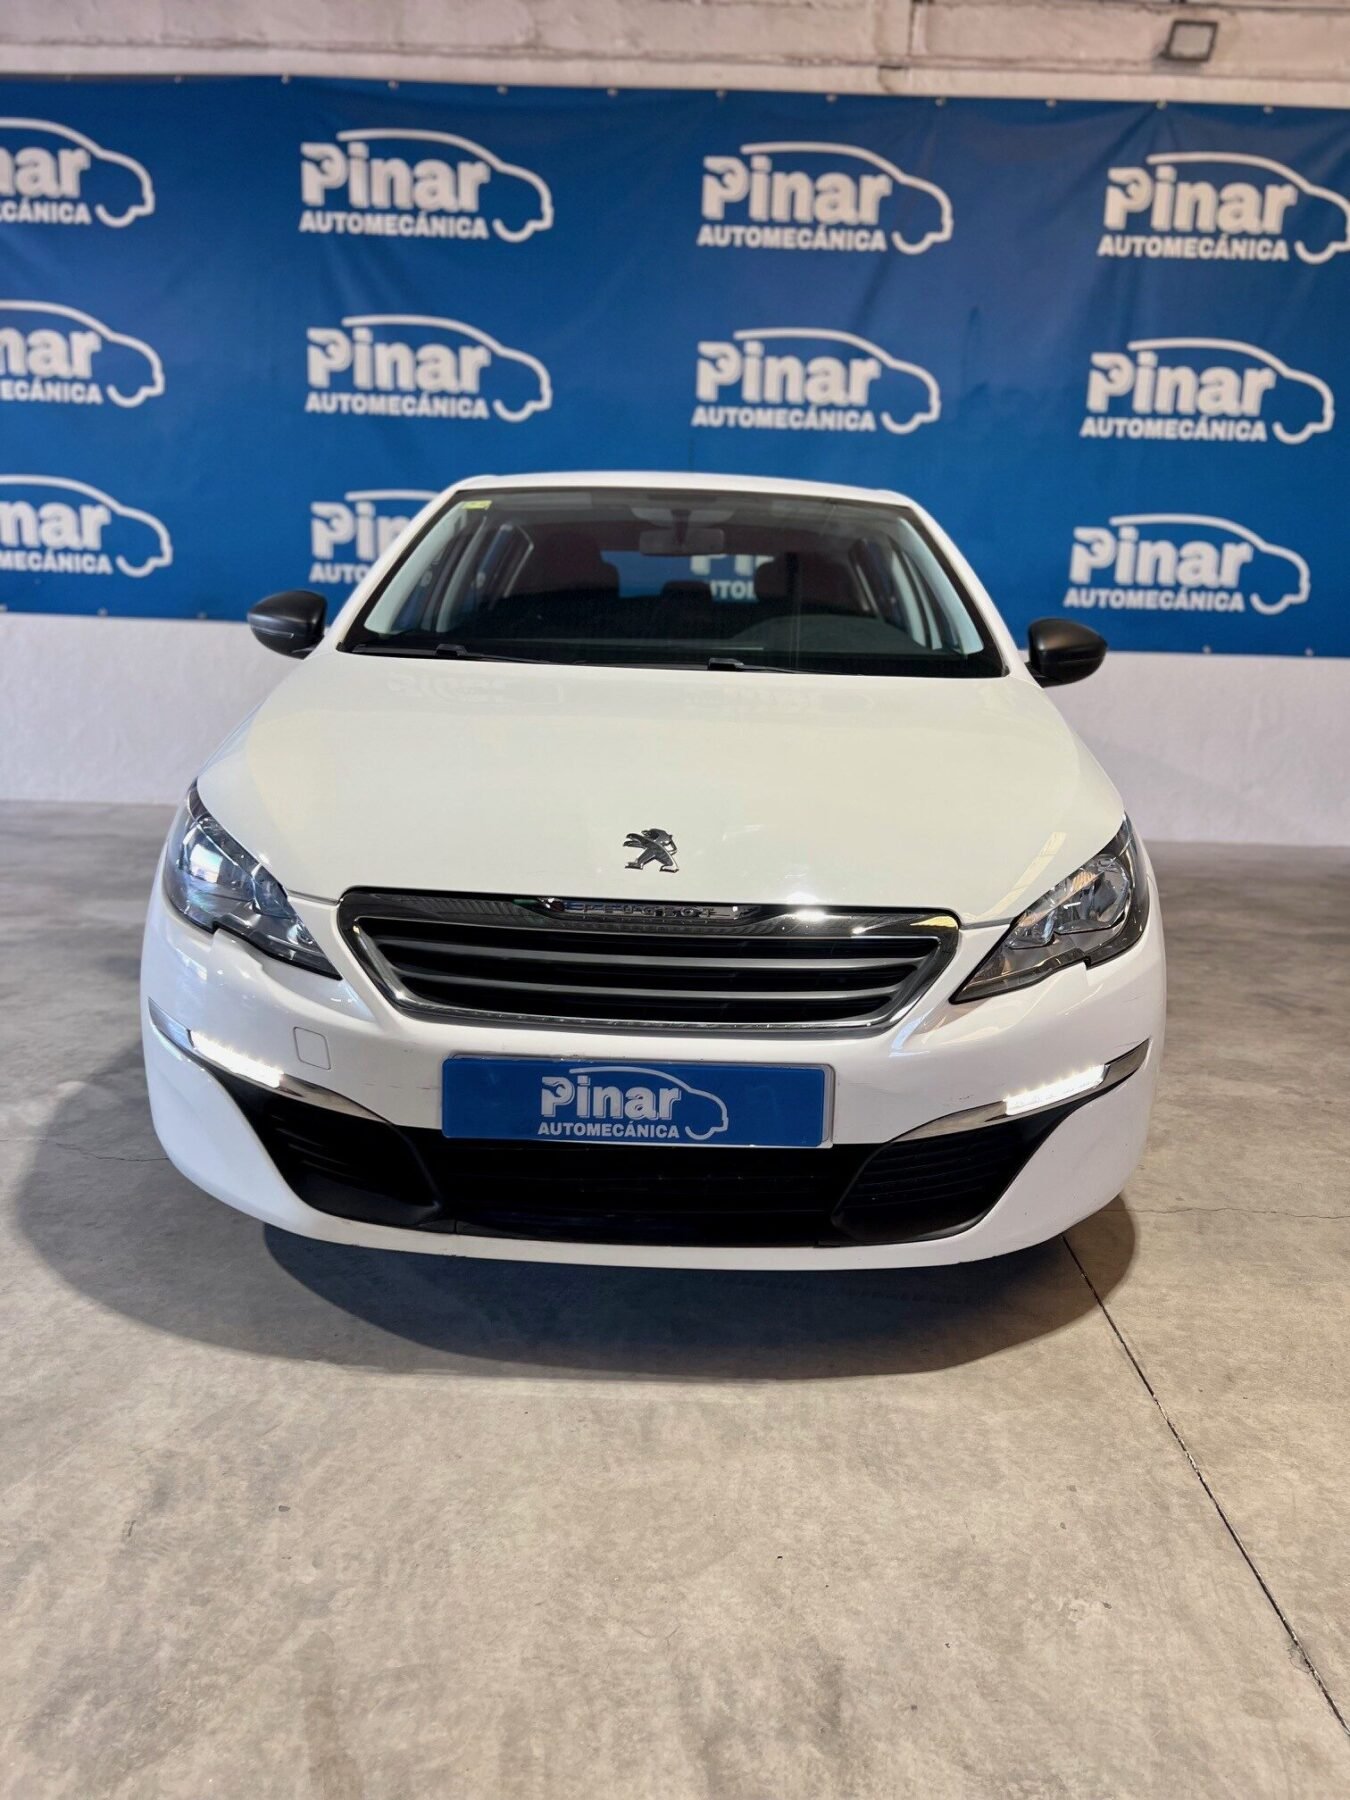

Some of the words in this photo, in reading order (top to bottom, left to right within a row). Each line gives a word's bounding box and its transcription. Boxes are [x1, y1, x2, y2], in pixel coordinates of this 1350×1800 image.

[301, 141, 490, 213] Pinar
[703, 154, 892, 225] Pinar
[1104, 165, 1298, 235] Pinar
[300, 210, 489, 240] AUTOMECÁNICA
[697, 222, 886, 252] AUTOMECÁNICA
[1098, 233, 1289, 262] AUTOMECÁNICA
[307, 328, 491, 393] Pinar
[696, 340, 880, 406] Pinar
[1087, 349, 1275, 416] Pinar
[305, 391, 489, 419] AUTOMECÁNICA
[692, 404, 876, 432] AUTOMECÁNICA
[1080, 414, 1268, 443] AUTOMECÁNICA
[1070, 524, 1252, 588] Pinar
[1063, 585, 1245, 614] AUTOMECÁNICA
[541, 1075, 682, 1120] Pinar
[537, 1121, 681, 1139] AUTOMECÁNICA
